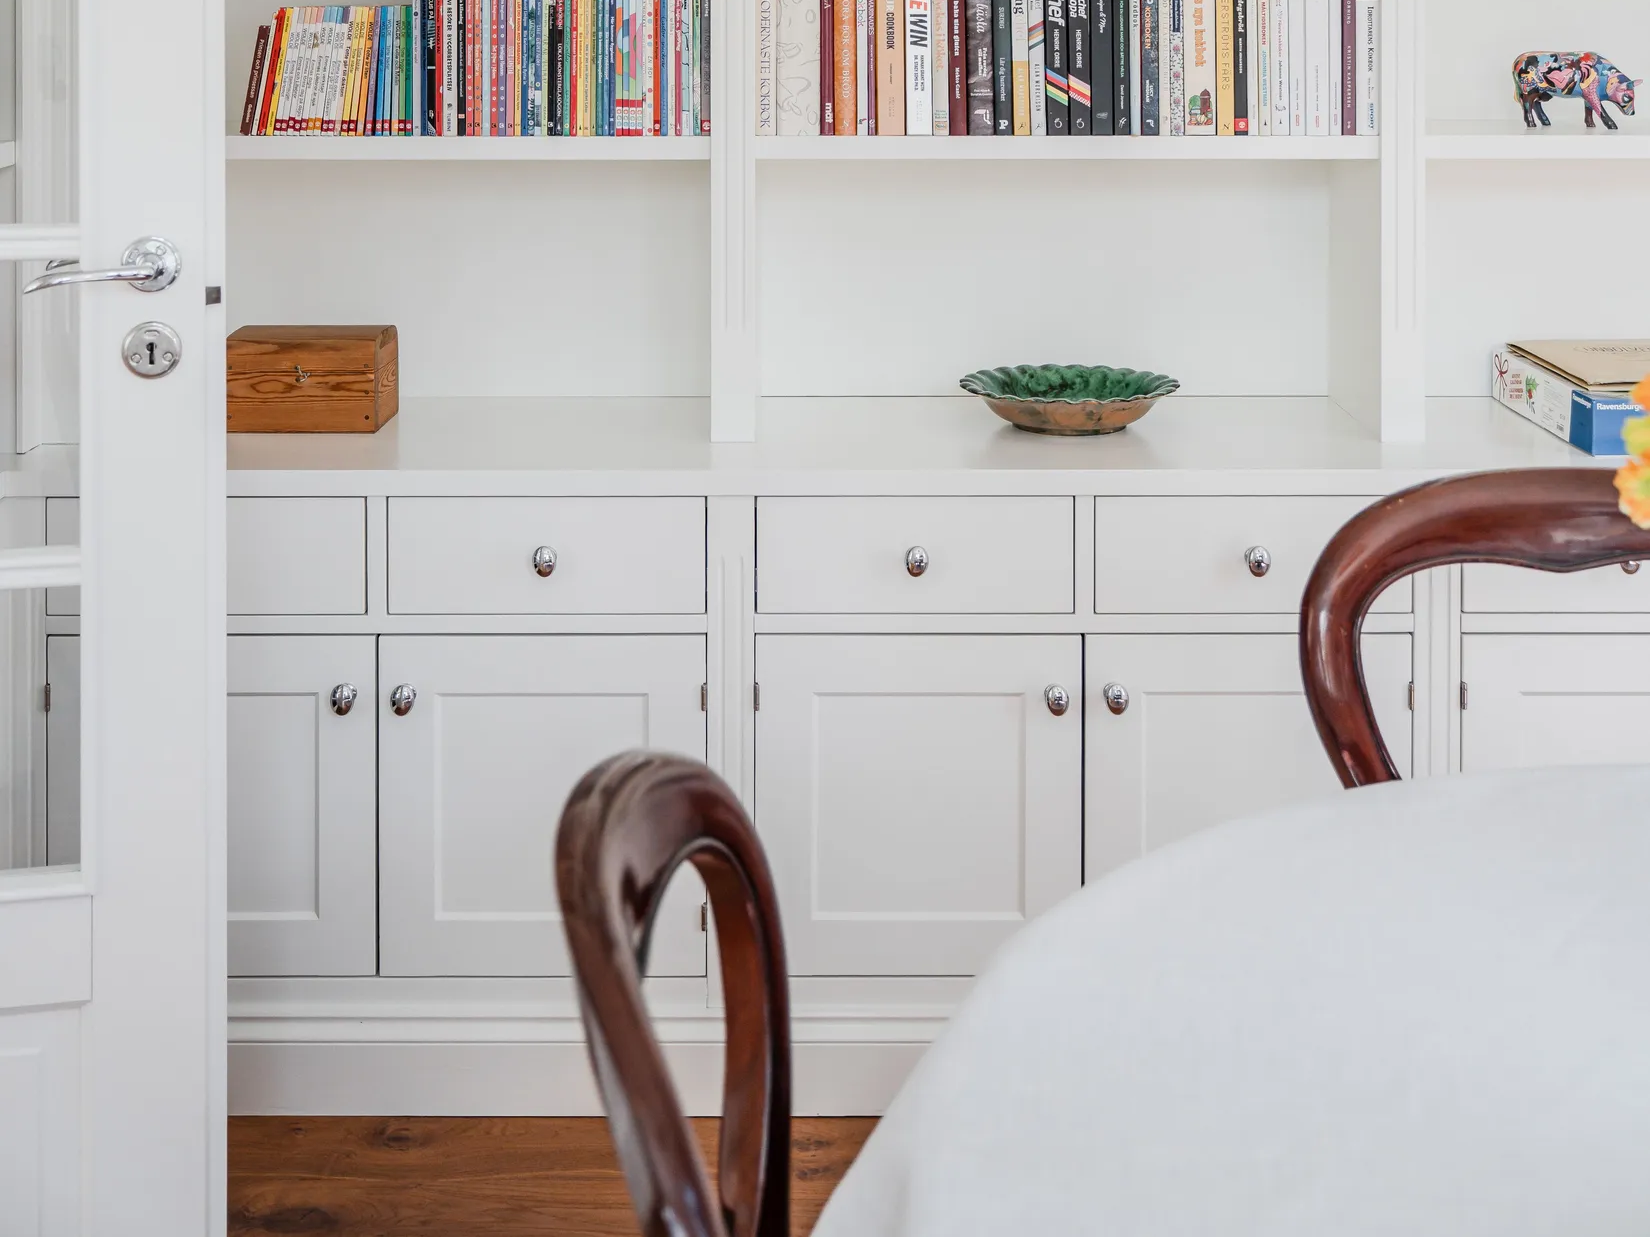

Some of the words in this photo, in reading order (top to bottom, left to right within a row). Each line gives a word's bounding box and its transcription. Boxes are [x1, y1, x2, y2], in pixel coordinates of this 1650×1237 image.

[446, 7, 454, 31] BESÖKER
[975, 2, 989, 34] bästa
[1144, 7, 1152, 49] KOKBOKEN
[841, 24, 851, 44] BOK
[909, 13, 928, 48] WIN
[1053, 28, 1061, 51] HENRIK
[1075, 29, 1083, 51] HENRIK
[841, 49, 851, 67] OM
[1053, 52, 1061, 68] ORRE
[841, 70, 853, 98] BRÖD
[1220, 61, 1233, 91] FÄRS
[759, 77, 771, 129] KOKBOK
[1596, 402, 1645, 413] Ravensburge
